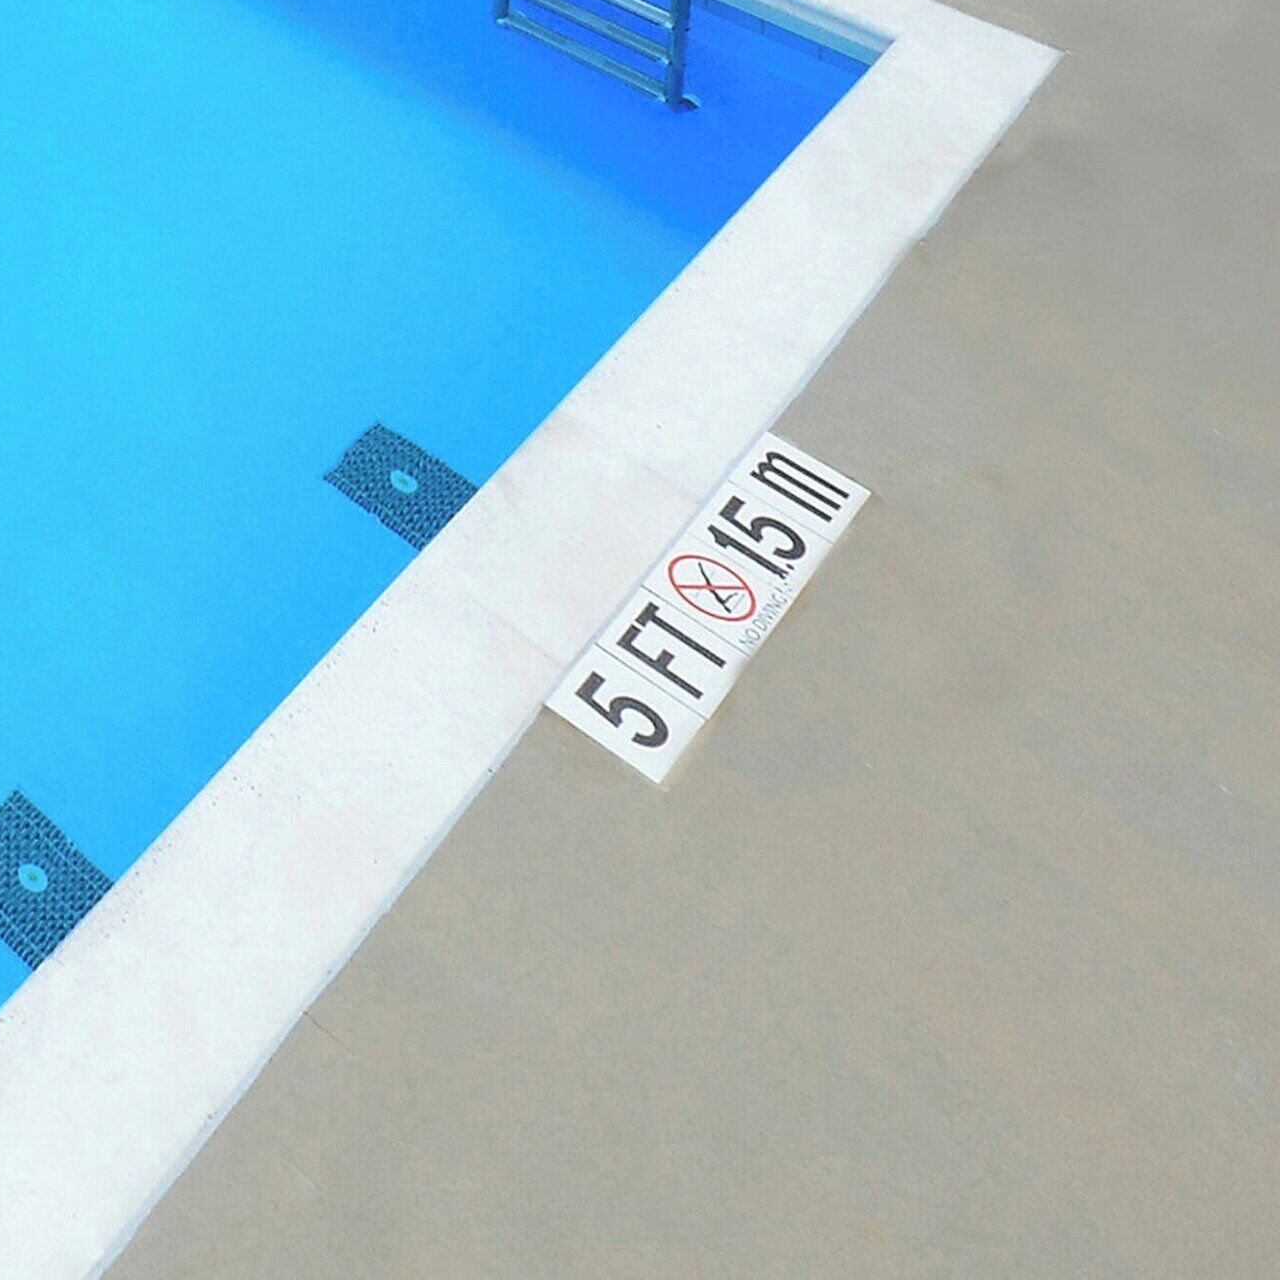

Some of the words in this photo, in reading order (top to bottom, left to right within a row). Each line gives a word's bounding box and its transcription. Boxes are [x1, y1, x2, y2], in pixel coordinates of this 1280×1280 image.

[749, 451, 850, 523] m
[616, 601, 727, 700] FT
[739, 627, 761, 648] NO
[574, 671, 669, 749] 5
